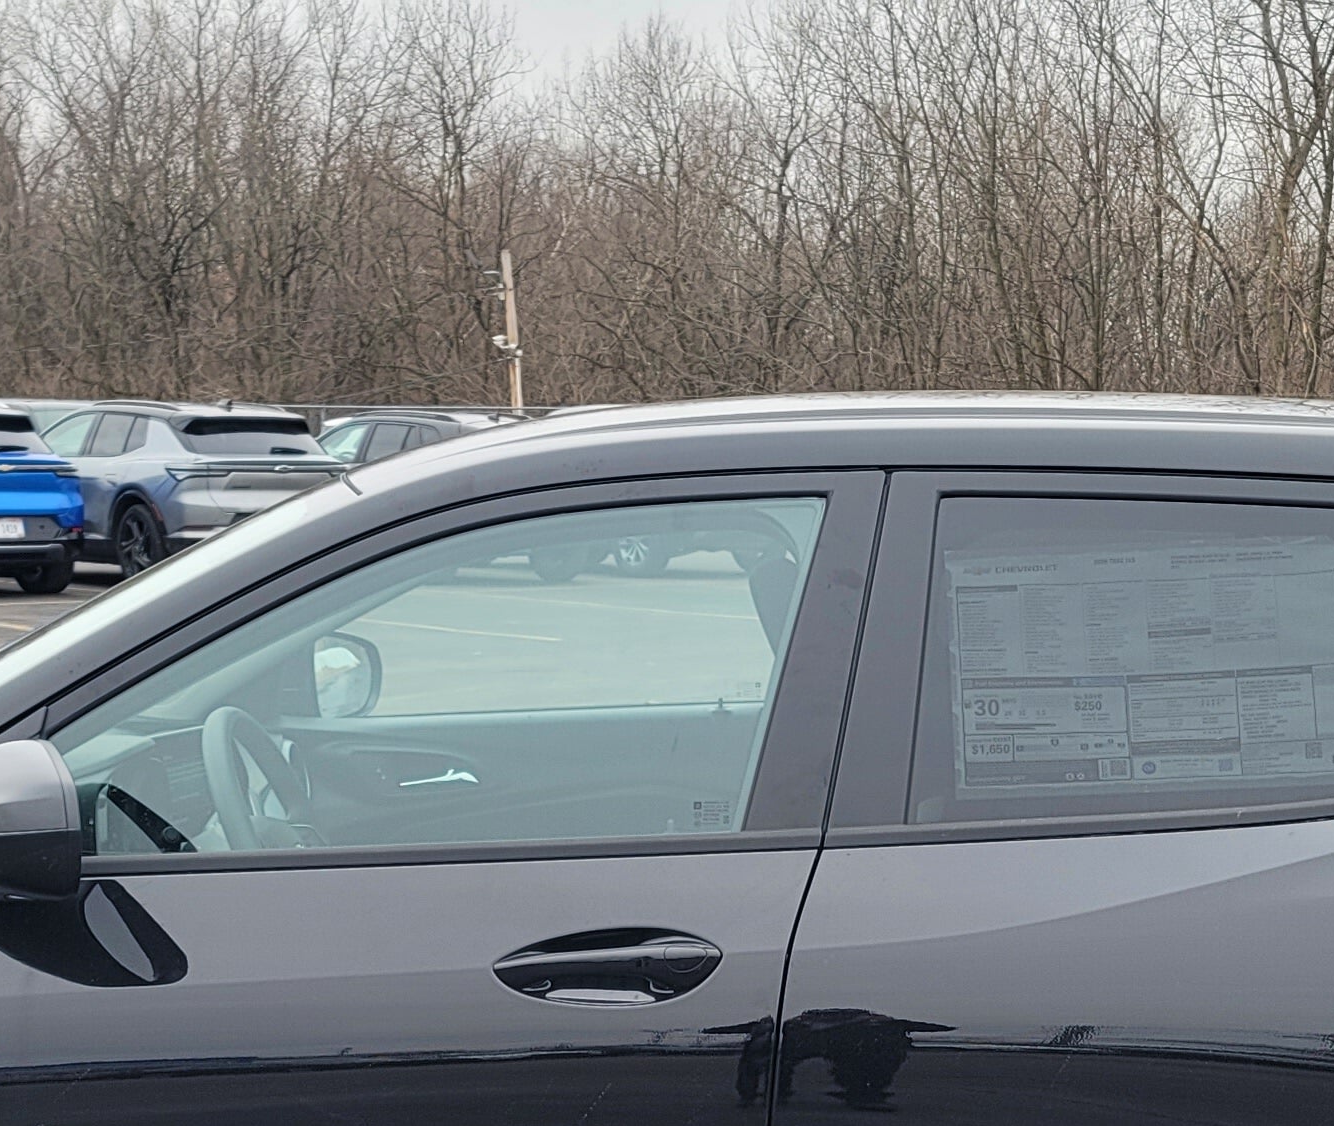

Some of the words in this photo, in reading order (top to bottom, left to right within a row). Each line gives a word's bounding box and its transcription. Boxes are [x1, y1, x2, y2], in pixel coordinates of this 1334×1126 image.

[973, 699, 1000, 717] 30
[1074, 700, 1103, 711] $250
[971, 743, 1011, 756] $1,650
